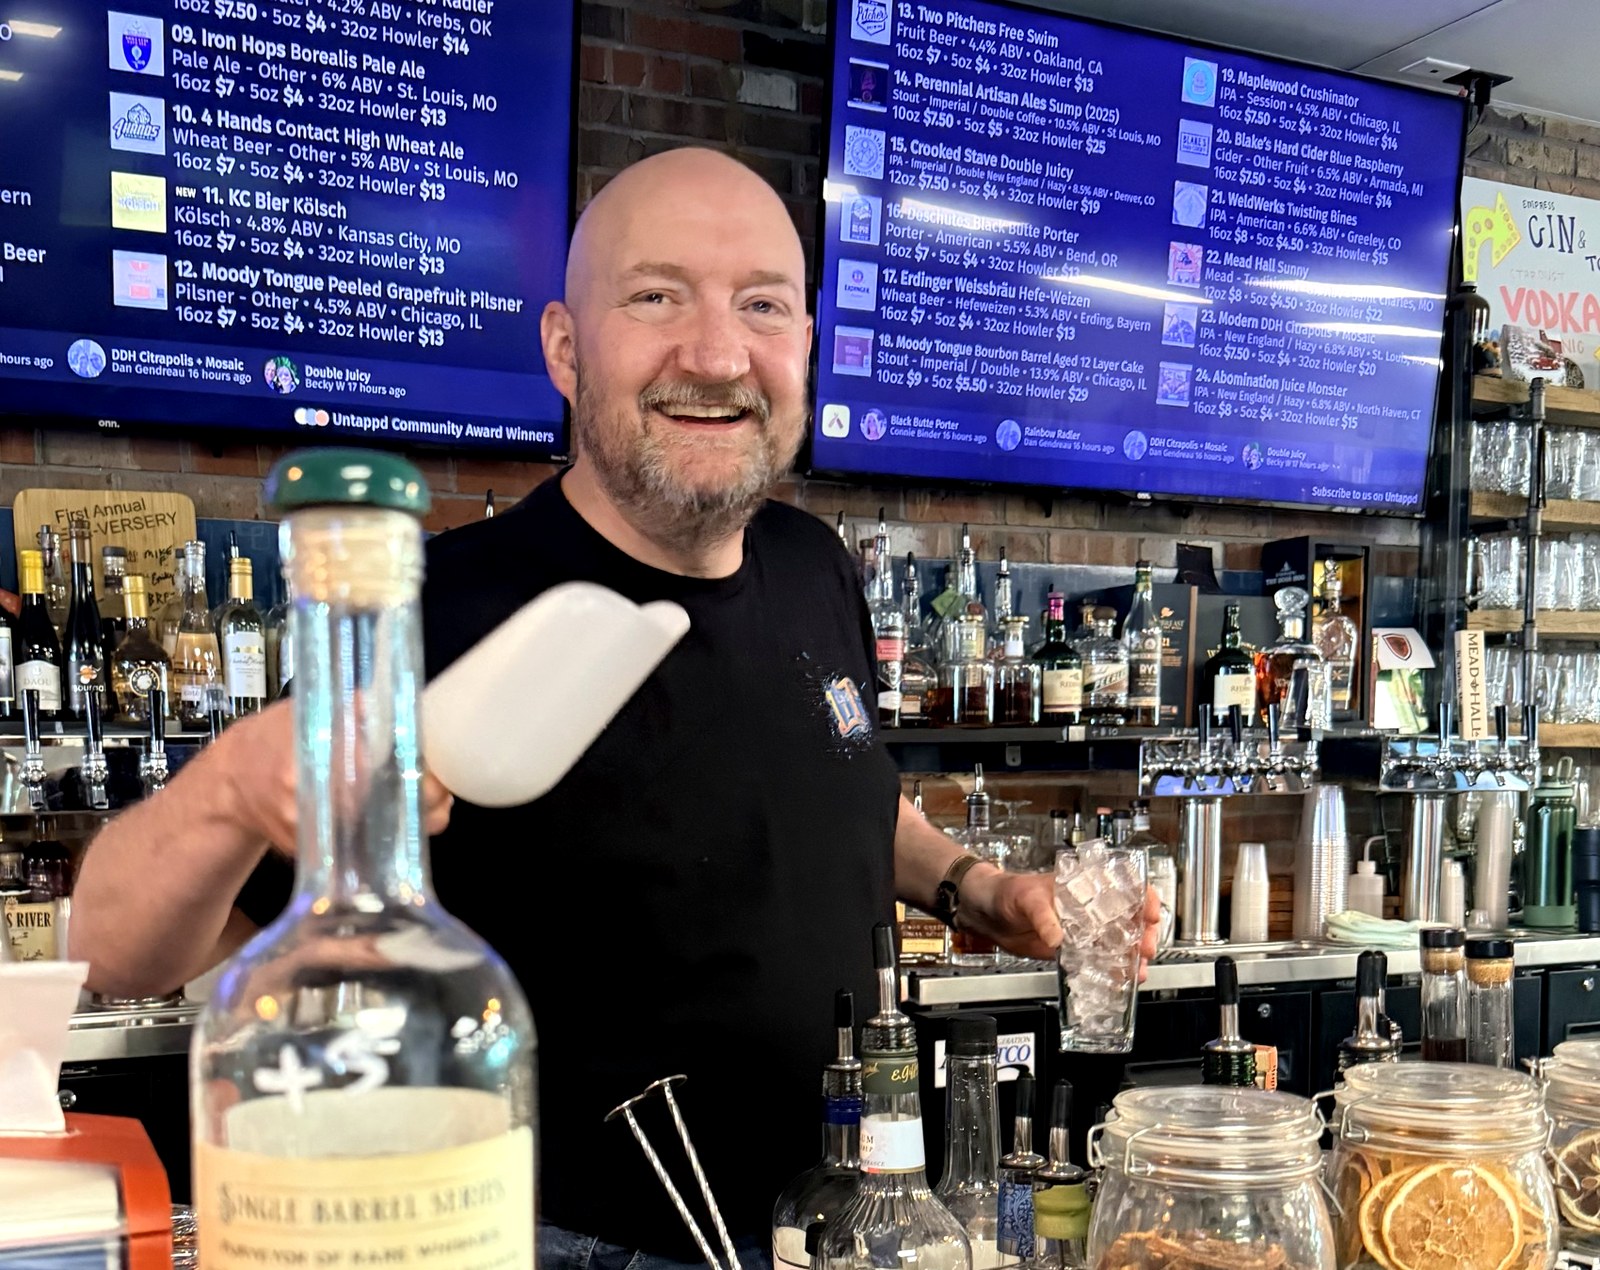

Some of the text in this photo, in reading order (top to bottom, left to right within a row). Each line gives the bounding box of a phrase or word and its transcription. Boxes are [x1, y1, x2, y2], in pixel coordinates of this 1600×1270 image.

[214, 0, 256, 21] $7.50
[272, 8, 300, 28] 5oz
[305, 11, 326, 33] $4
[341, 19, 376, 40] 32oz
[382, 26, 438, 49] Howler
[442, 33, 469, 55] $14
[327, 0, 491, 36] 4.2% ABV Krebs, OK
[897, 2, 914, 19] 13.
[917, 5, 942, 24] Two
[946, 12, 996, 35] Pitchers
[998, 22, 1024, 41] Free
[1026, 28, 1058, 47] Swim
[171, 24, 196, 44] 09.
[202, 28, 236, 50] Iron
[242, 35, 286, 59] Hops
[290, 43, 357, 68] Borealis
[362, 54, 395, 74] Pale
[400, 60, 424, 79] Ale
[172, 48, 496, 111] Pale Ale Other 6% ABV St. Louis, MO
[894, 69, 1119, 125] 14. Perennial Artisan Ales Sump (2025)
[1221, 68, 1358, 107] 19. Maplewood Crushinator
[172, 104, 463, 160] 10. 4 Hands Contact High Wheat Ale
[172, 128, 228, 150] Wheat
[233, 135, 272, 155] Beer
[289, 143, 336, 163] Other
[351, 151, 374, 169] 5%
[378, 155, 409, 173] ABV
[424, 161, 440, 178] St
[445, 164, 488, 187] Louis,
[494, 170, 517, 188] MO
[890, 136, 1073, 182] 15. Crooked Stave Double Juicy
[1216, 128, 1232, 144] 20.
[1234, 132, 1271, 151] Blake's
[1273, 139, 1298, 156] Hard
[1300, 144, 1328, 161] Cider
[1329, 149, 1352, 166] Blue
[1354, 155, 1403, 178] Raspberry
[175, 186, 346, 218] NEW 11. KC Bier Kölsch
[1211, 189, 1356, 226] 21. WeldWerks Twisting Bines
[1522, 200, 1556, 211] EMPRESS
[174, 206, 460, 255] Kölsch 4.8% ABV Kansas City, MO
[1009, 223, 1040, 239] Butte
[1043, 226, 1079, 244] Porter
[1528, 214, 1587, 254] GIN &
[4, 243, 47, 263] Beer
[1206, 249, 1309, 280] 22. Mead Hall Sunny
[174, 260, 522, 312] 12. Moody Tongue Peeled Grapefruit Pilsner
[882, 268, 1092, 307] 17. Erdinger Weissbräu Hefe-Weizen
[175, 283, 482, 330] Pilsner Other 4.5% ABV Chicago, IL
[1201, 309, 1215, 323] 23.
[1218, 311, 1257, 328] Modern
[1261, 317, 1282, 332] DDH
[1499, 285, 1600, 334] VODKA
[111, 348, 136, 361] DDH
[139, 351, 193, 370] Citrapolis
[205, 357, 243, 371] Mosaic
[878, 333, 1144, 375] 18. Moody Tongue Bourbon Barrel Aged 12 Layer Cake
[305, 365, 370, 384] Double Juicy
[1195, 368, 1348, 397] 24. Abomination Juice Monster
[98, 419, 120, 429] onn.
[332, 413, 553, 442] Untappd Community Award Winners
[55, 498, 146, 524] First Annual
[1468, 633, 1482, 737] MEAD HALL
[16, 911, 51, 928] RIVER
